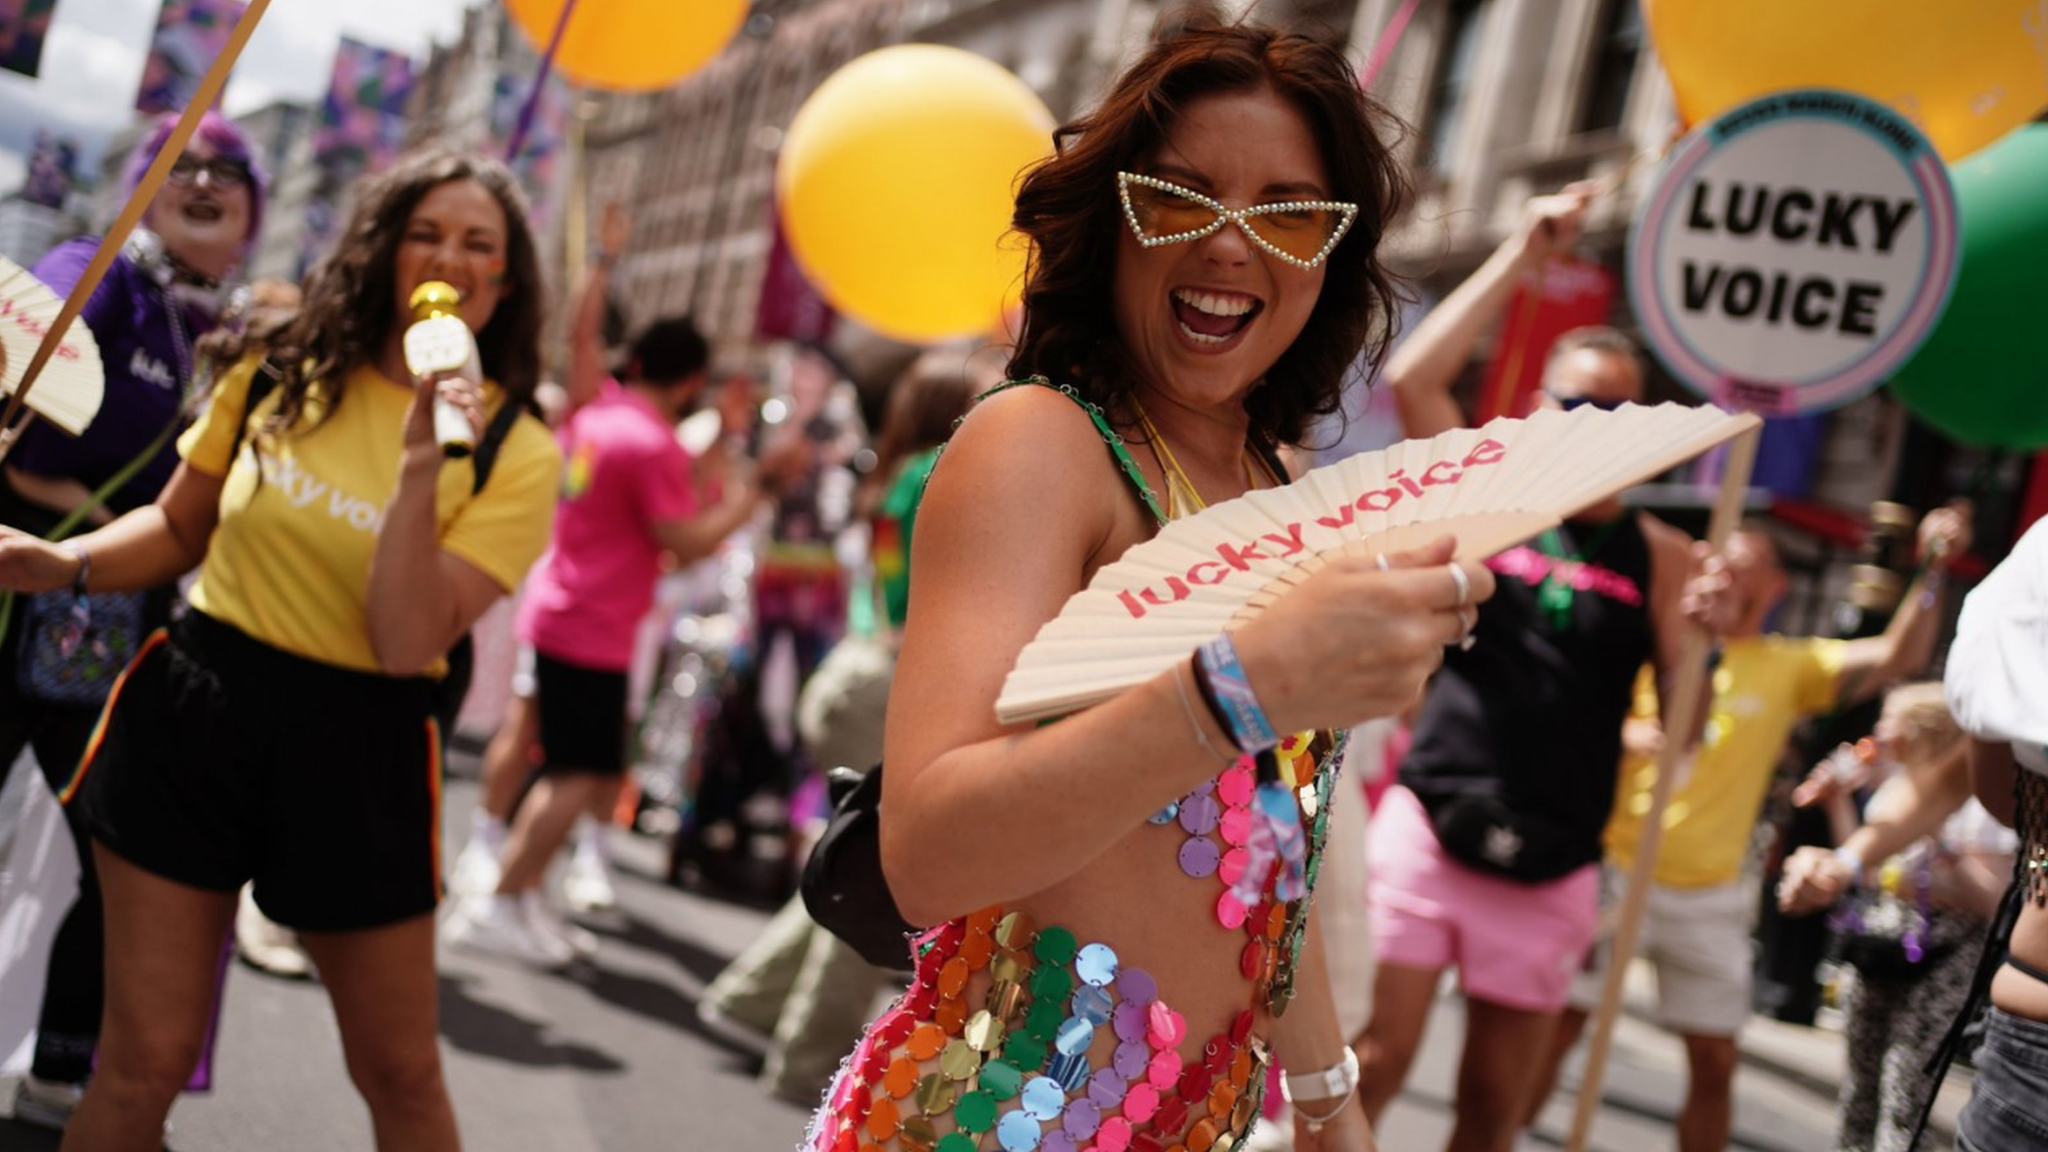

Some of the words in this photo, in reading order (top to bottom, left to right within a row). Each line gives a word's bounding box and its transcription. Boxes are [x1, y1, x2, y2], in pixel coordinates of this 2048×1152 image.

[1687, 182, 1916, 254] LUCKY
[1681, 262, 1884, 336] VOICE
[1117, 523, 1304, 619] lucky
[1315, 438, 1506, 529] voice
